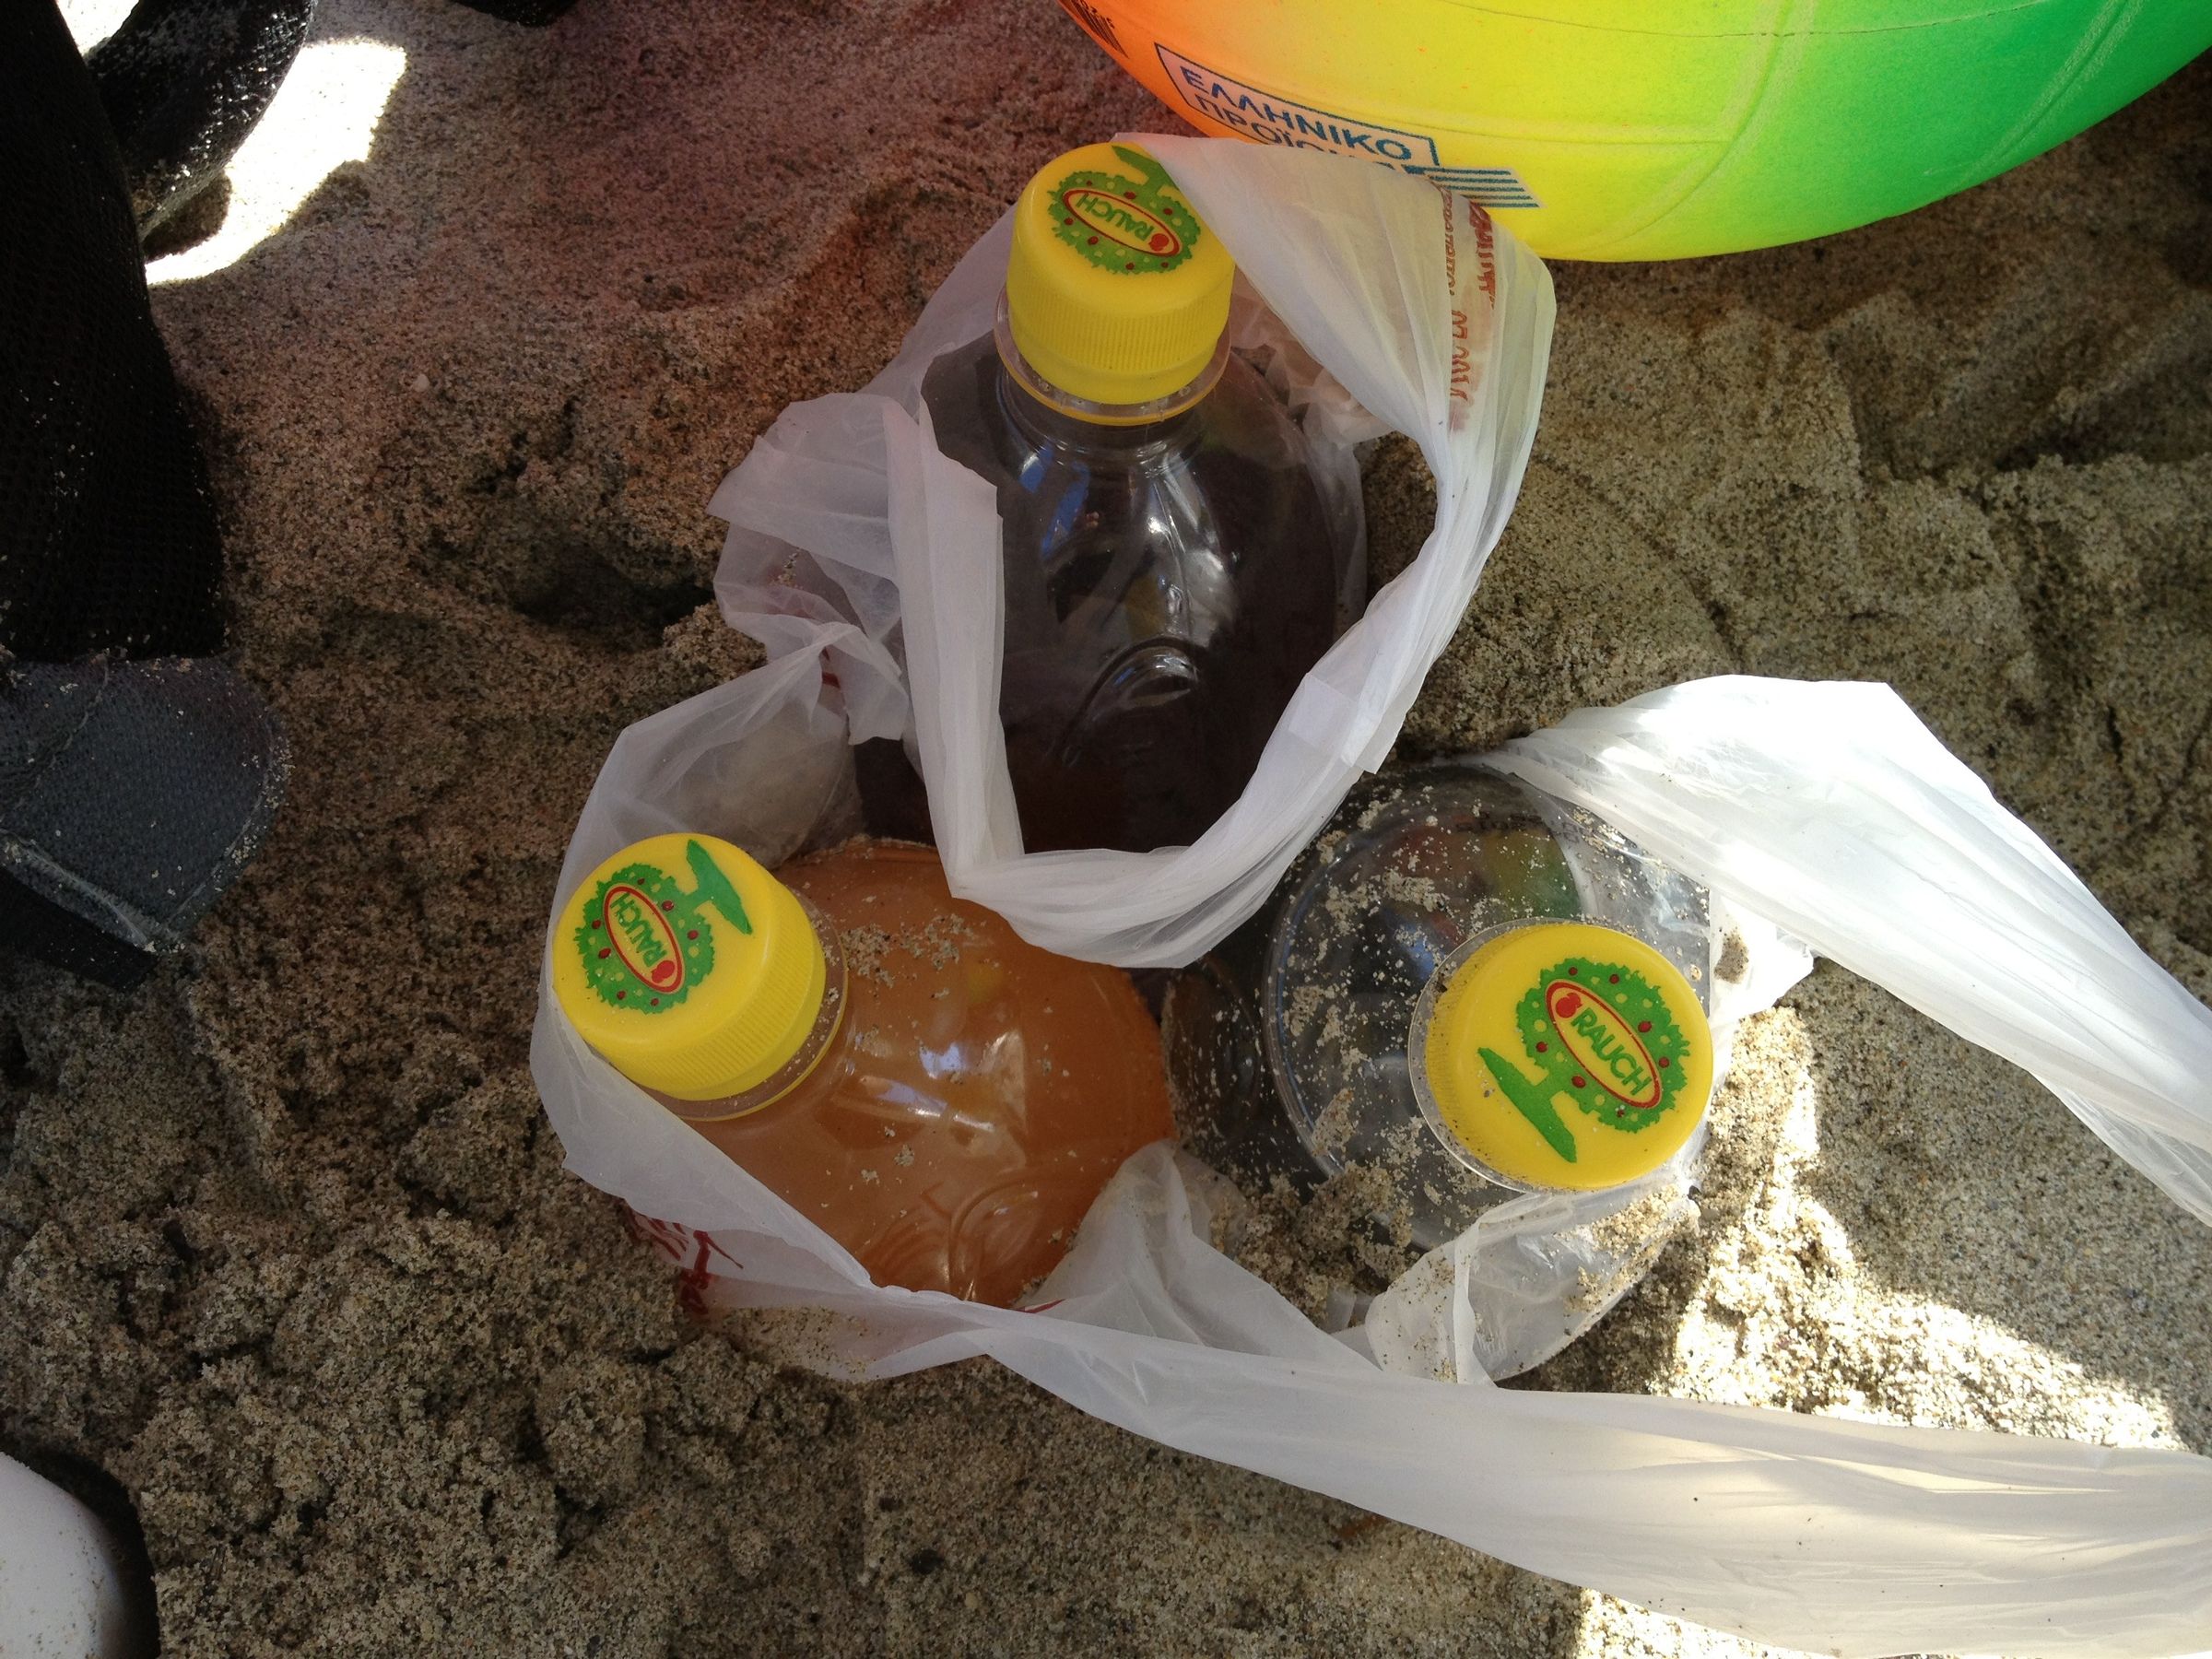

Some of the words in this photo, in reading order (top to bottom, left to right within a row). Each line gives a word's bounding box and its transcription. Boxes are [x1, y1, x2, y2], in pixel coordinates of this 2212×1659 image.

[1180, 65, 1412, 160] ΕΛΛΗΝΙΚΟ
[1076, 192, 1155, 241] RAUCH
[609, 891, 668, 968] RAUCH
[1571, 1007, 1653, 1096] RAUCH
